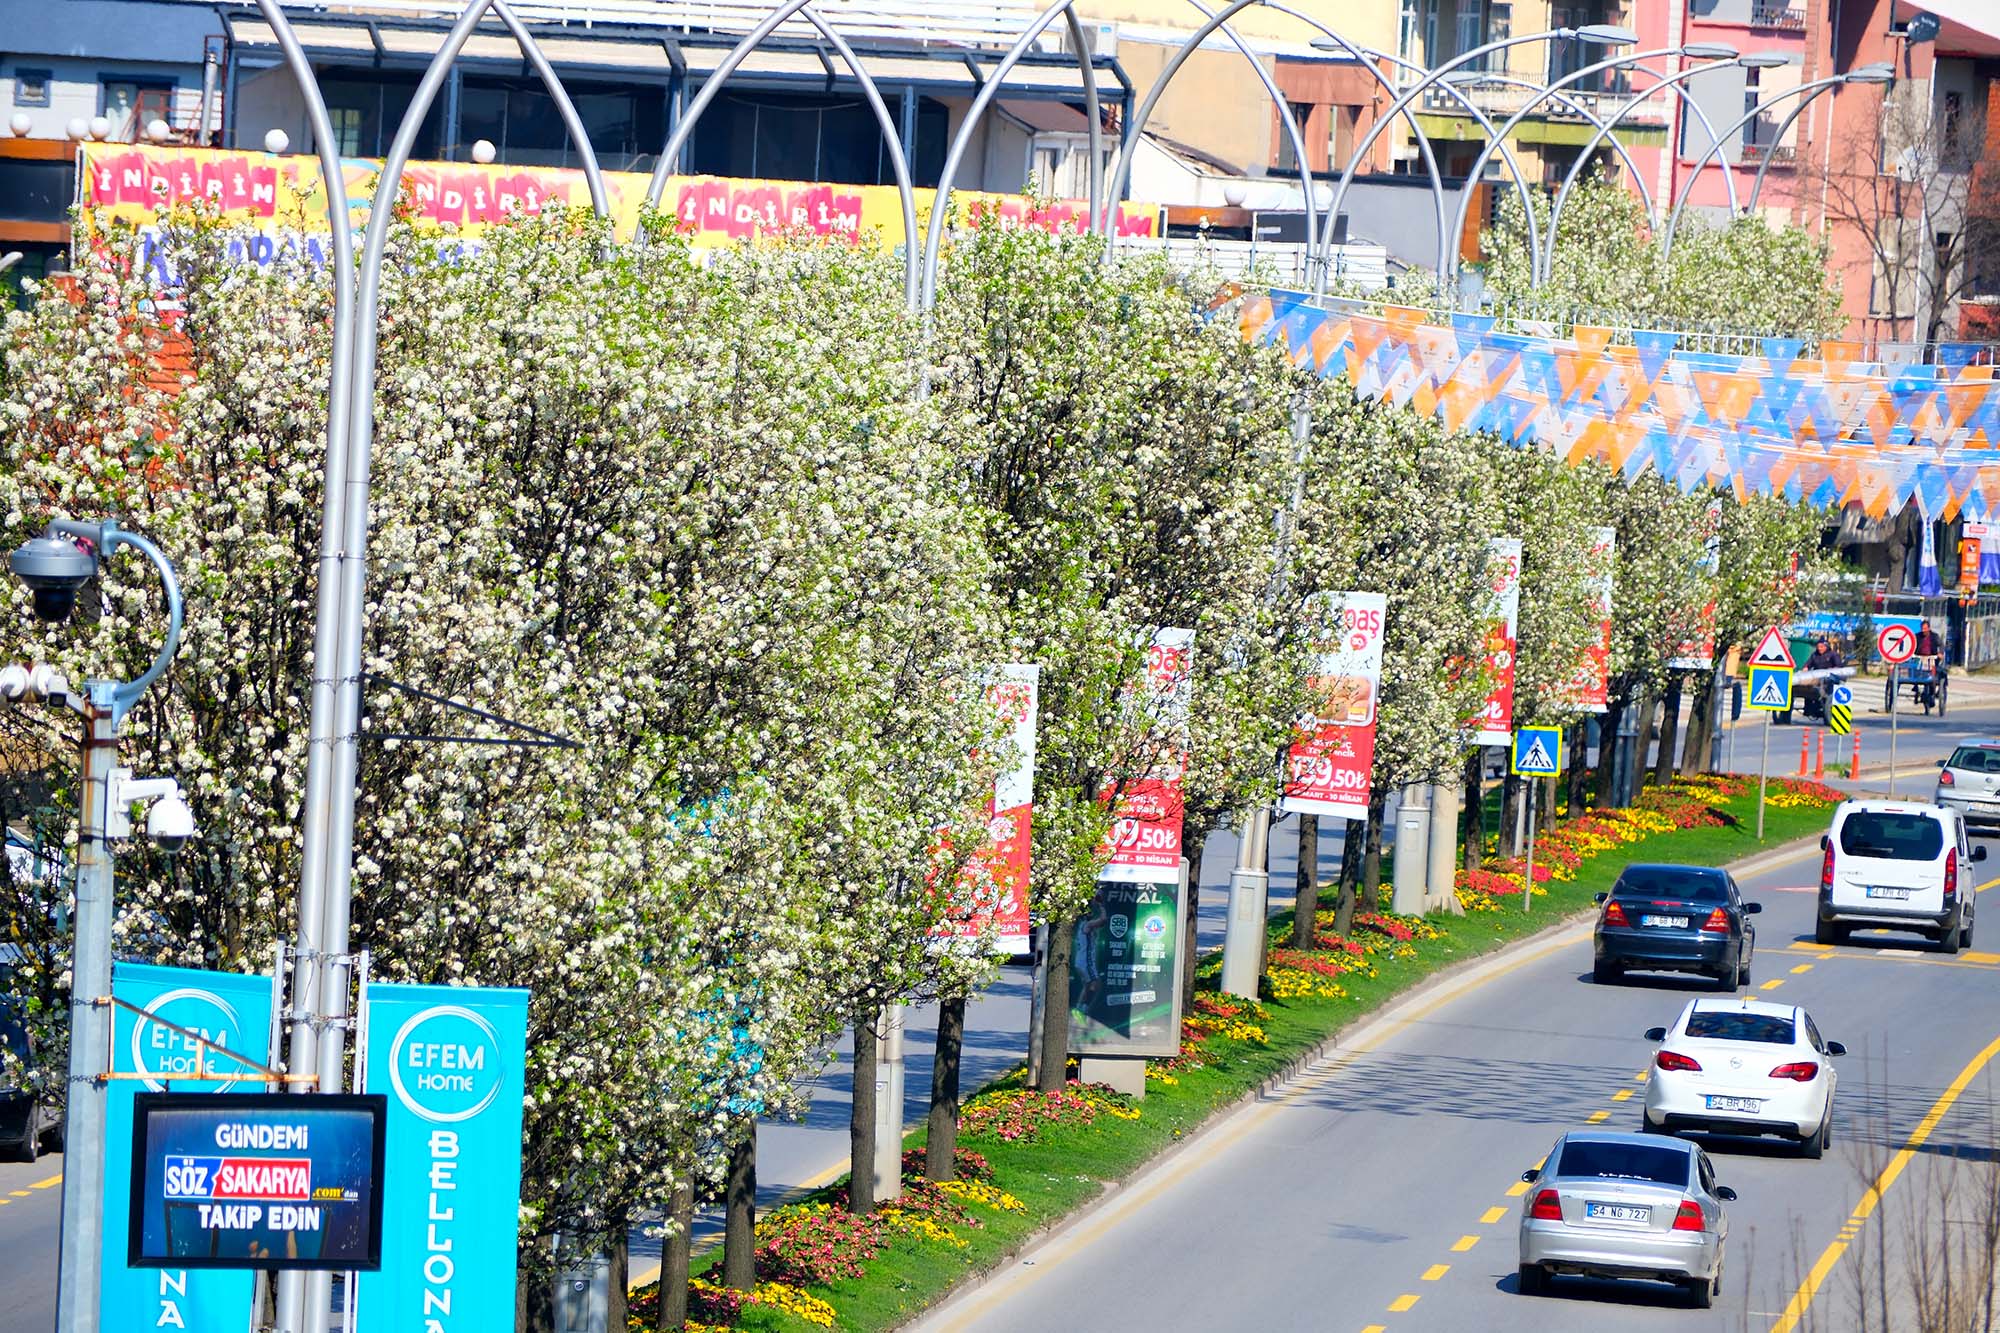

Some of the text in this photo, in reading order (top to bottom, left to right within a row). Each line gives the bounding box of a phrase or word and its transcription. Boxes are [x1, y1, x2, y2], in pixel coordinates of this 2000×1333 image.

[409, 1042, 485, 1070] EFEM
[418, 1073, 474, 1092] HOME
[166, 1158, 208, 1196] SÖZ
[221, 1166, 308, 1195] SAKARYA
[198, 1204, 320, 1231] TAKİP EDİN
[1593, 1205, 1647, 1220] 54 NG 727
